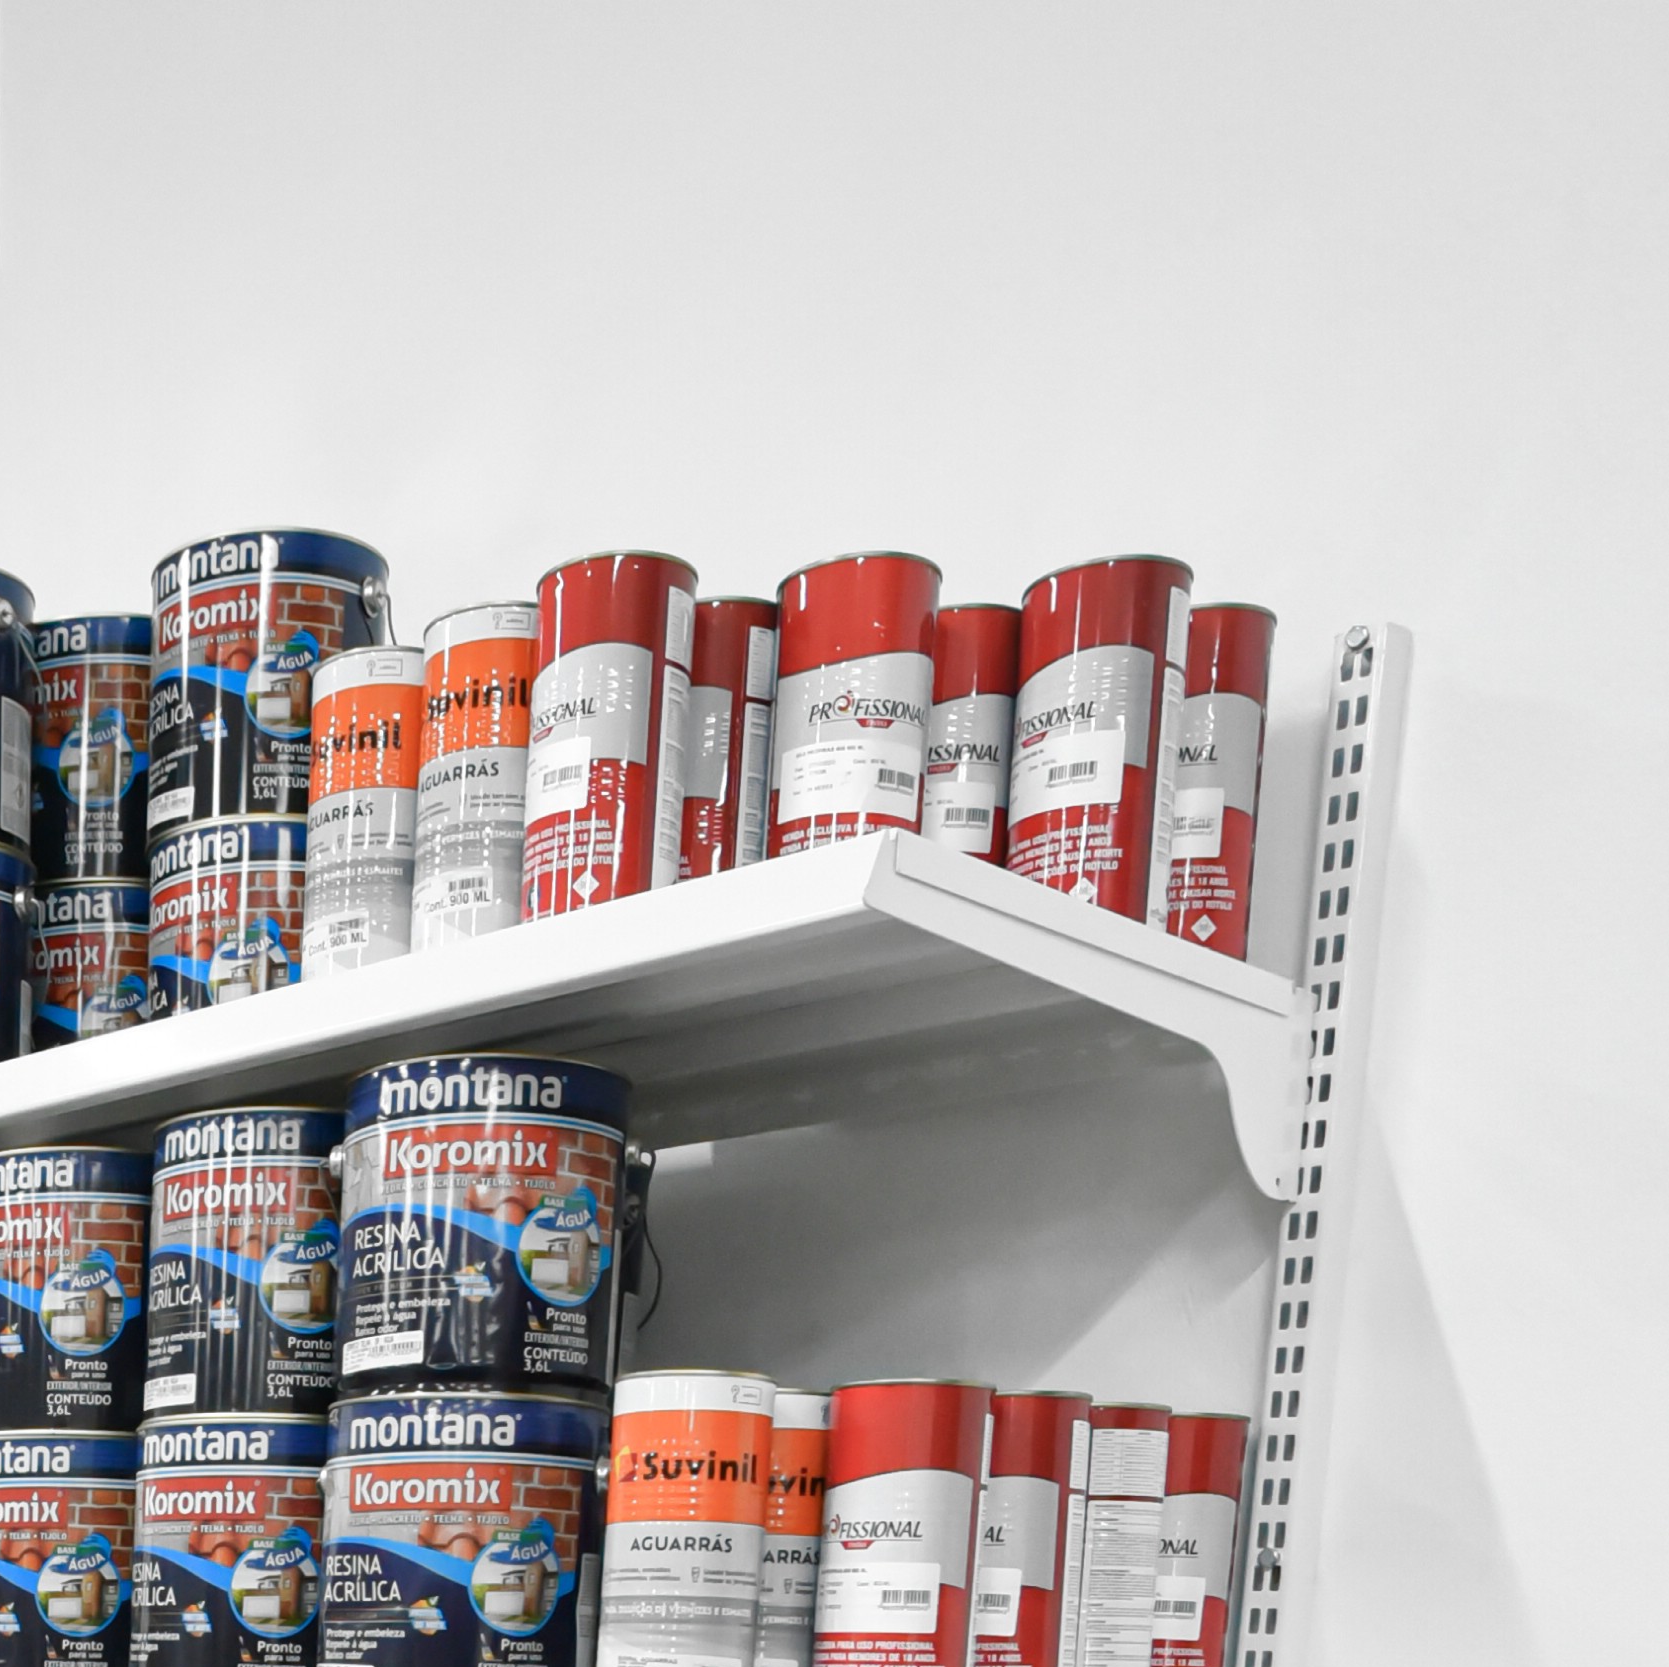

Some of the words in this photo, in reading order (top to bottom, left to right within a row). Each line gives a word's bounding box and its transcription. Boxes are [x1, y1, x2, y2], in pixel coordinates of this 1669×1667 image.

[808, 690, 927, 726] PROFISSIONAL
[380, 1071, 563, 1115] montana
[164, 1117, 300, 1163] montana
[388, 1129, 548, 1172] Koromix
[165, 1170, 287, 1213] Koromix
[555, 1208, 592, 1228] ÁGUA
[354, 1221, 422, 1250] RESINA
[295, 1239, 336, 1261] ÁGUA
[352, 1246, 445, 1279] ACRÍLICA
[70, 1267, 111, 1289] ÁGUA
[64, 1357, 108, 1371] Pronto
[45, 1391, 112, 1405] CONTEÚDO
[45, 1404, 72, 1416] 3,6L
[350, 1413, 516, 1449] montana
[143, 1430, 269, 1464] montana
[642, 1450, 758, 1483] Suvinil
[144, 1480, 256, 1516] Koromix
[354, 1467, 501, 1505] Koromix
[510, 1540, 549, 1561] ÁGUA
[629, 1533, 733, 1552] AGUARRÁS
[68, 1552, 107, 1572] ÁGUA
[265, 1547, 306, 1568] ÁGUA
[326, 1554, 383, 1576] RESINA
[323, 1575, 403, 1603] ACRÍLICA
[500, 1638, 544, 1654] Pronto
